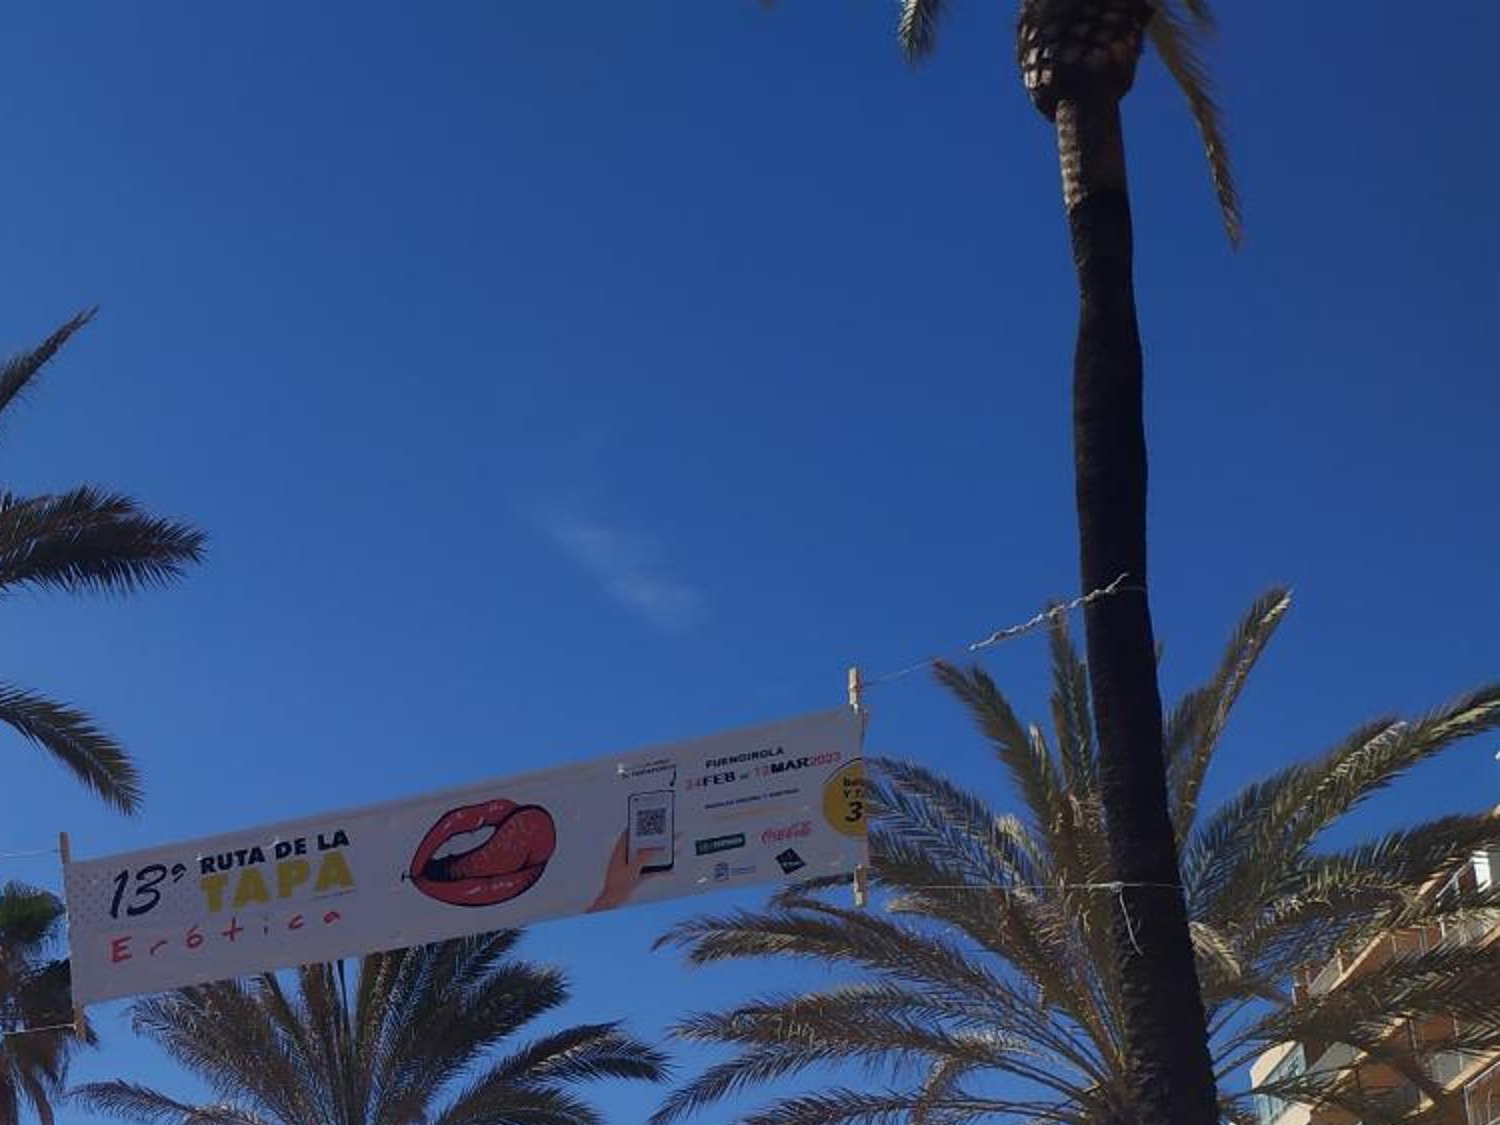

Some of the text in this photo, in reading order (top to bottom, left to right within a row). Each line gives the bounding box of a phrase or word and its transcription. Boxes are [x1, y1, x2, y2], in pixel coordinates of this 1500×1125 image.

[705, 746, 785, 769] FUENGIROLA
[199, 847, 266, 875] RUTA
[274, 838, 307, 860] DE
[317, 828, 350, 851] LA
[201, 851, 356, 913] TAPA
[109, 909, 342, 964] Erótica
